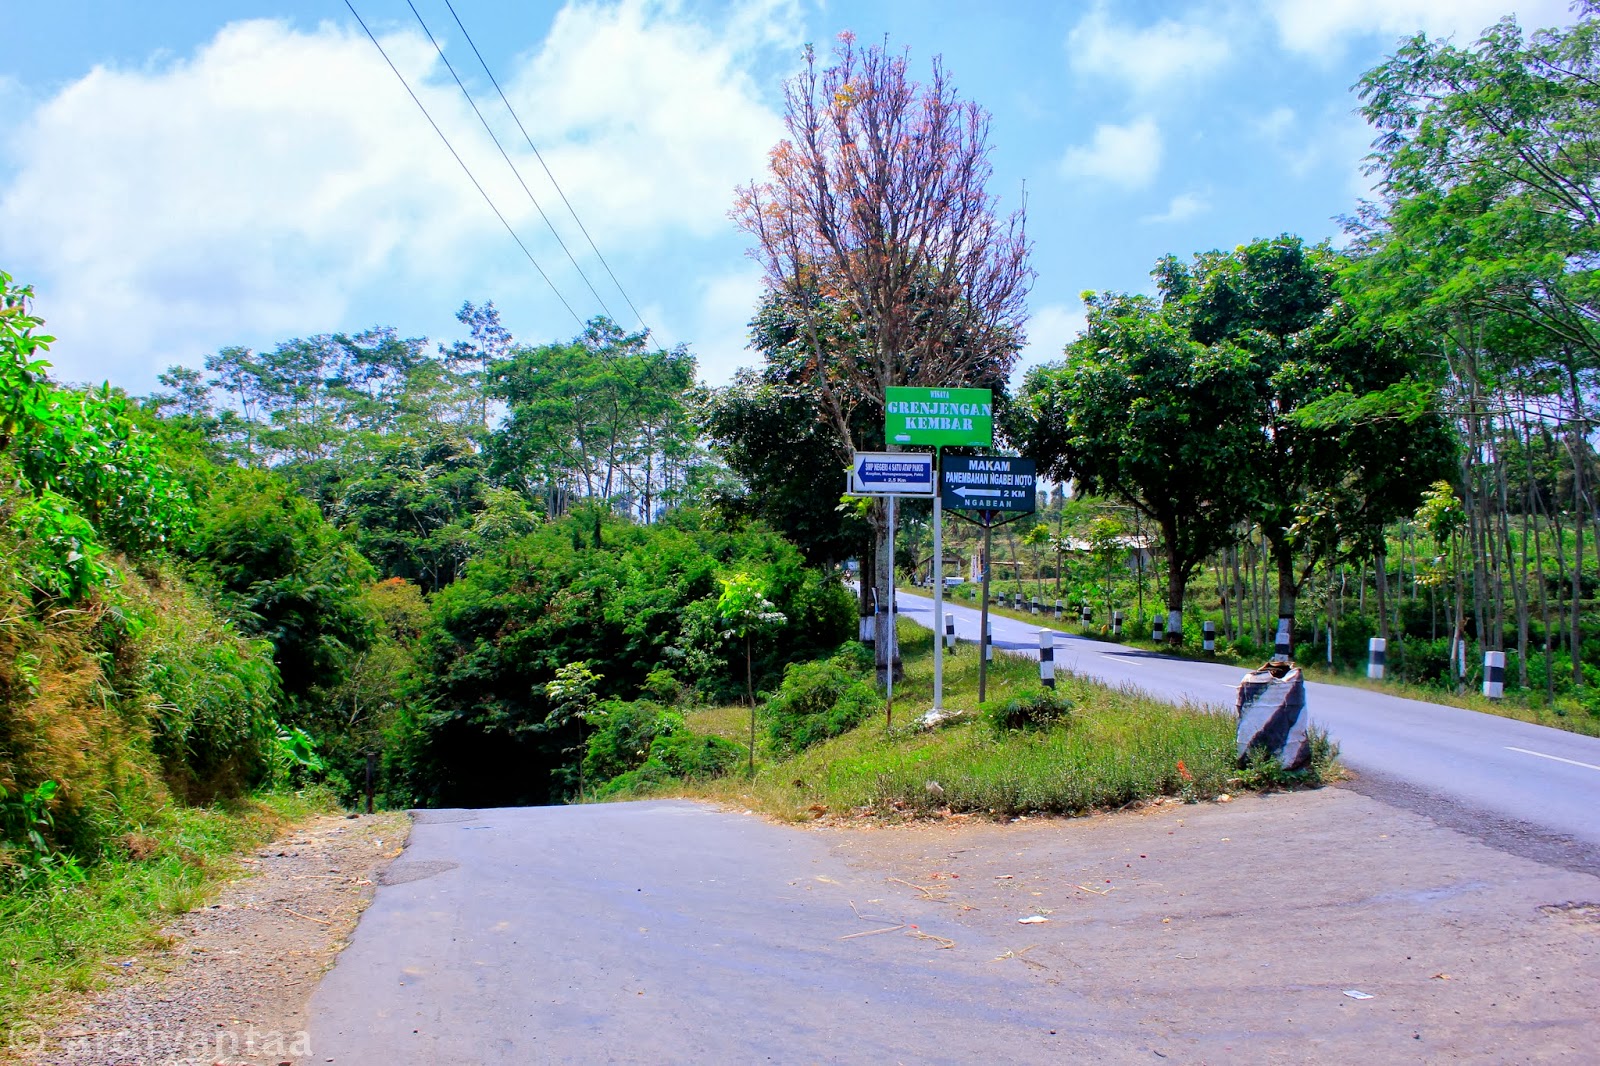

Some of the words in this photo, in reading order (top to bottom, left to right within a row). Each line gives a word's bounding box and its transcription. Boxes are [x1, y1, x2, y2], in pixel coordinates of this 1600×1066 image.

[930, 390, 950, 399] WISATA
[887, 401, 992, 416] GRENJENGAN
[905, 417, 973, 431] KEMBAR
[968, 460, 1011, 471] MAKAM
[945, 472, 989, 484] PANEMBAHAN
[989, 473, 1014, 485] NGABEI
[1014, 475, 1033, 486] NOTO
[1011, 490, 1026, 498] KM
[964, 499, 1012, 507] NGABEAN
